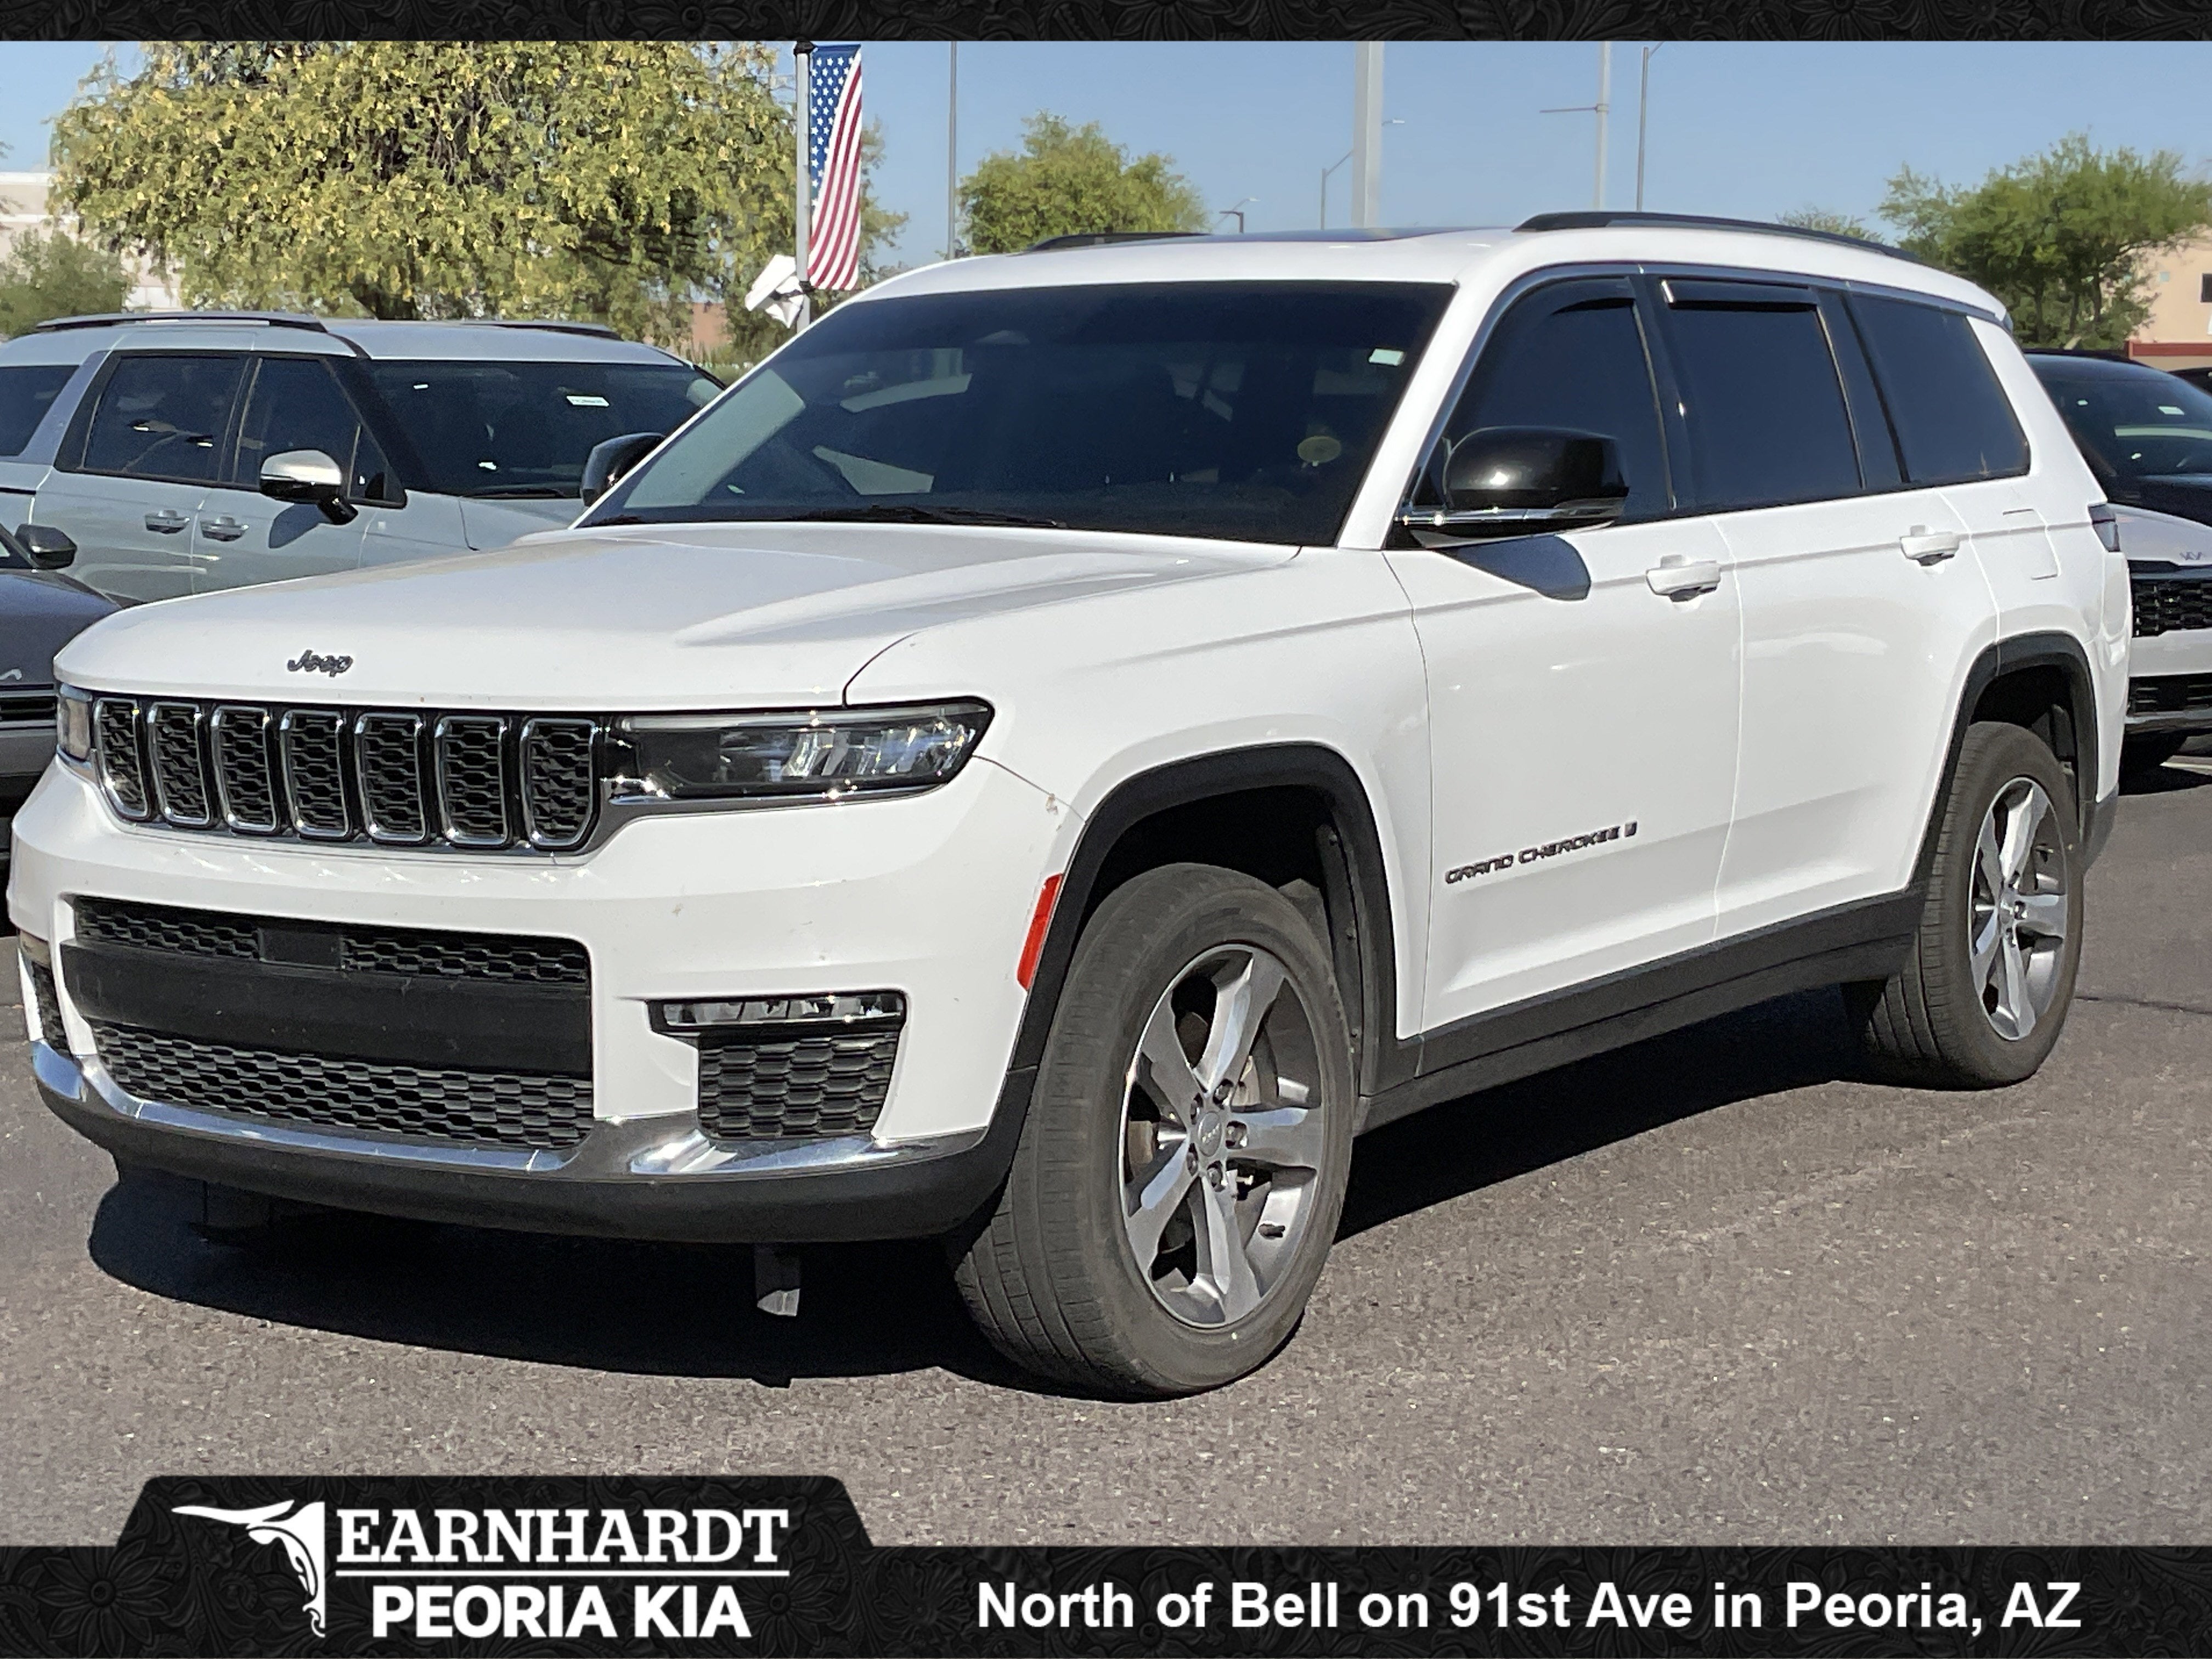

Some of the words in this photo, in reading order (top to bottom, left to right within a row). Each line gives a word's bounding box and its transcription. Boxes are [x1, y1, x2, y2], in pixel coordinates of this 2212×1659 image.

[287, 649, 354, 678] Jeep
[1444, 854, 1514, 884] GRAND
[1518, 826, 1621, 864] CHEROKEE
